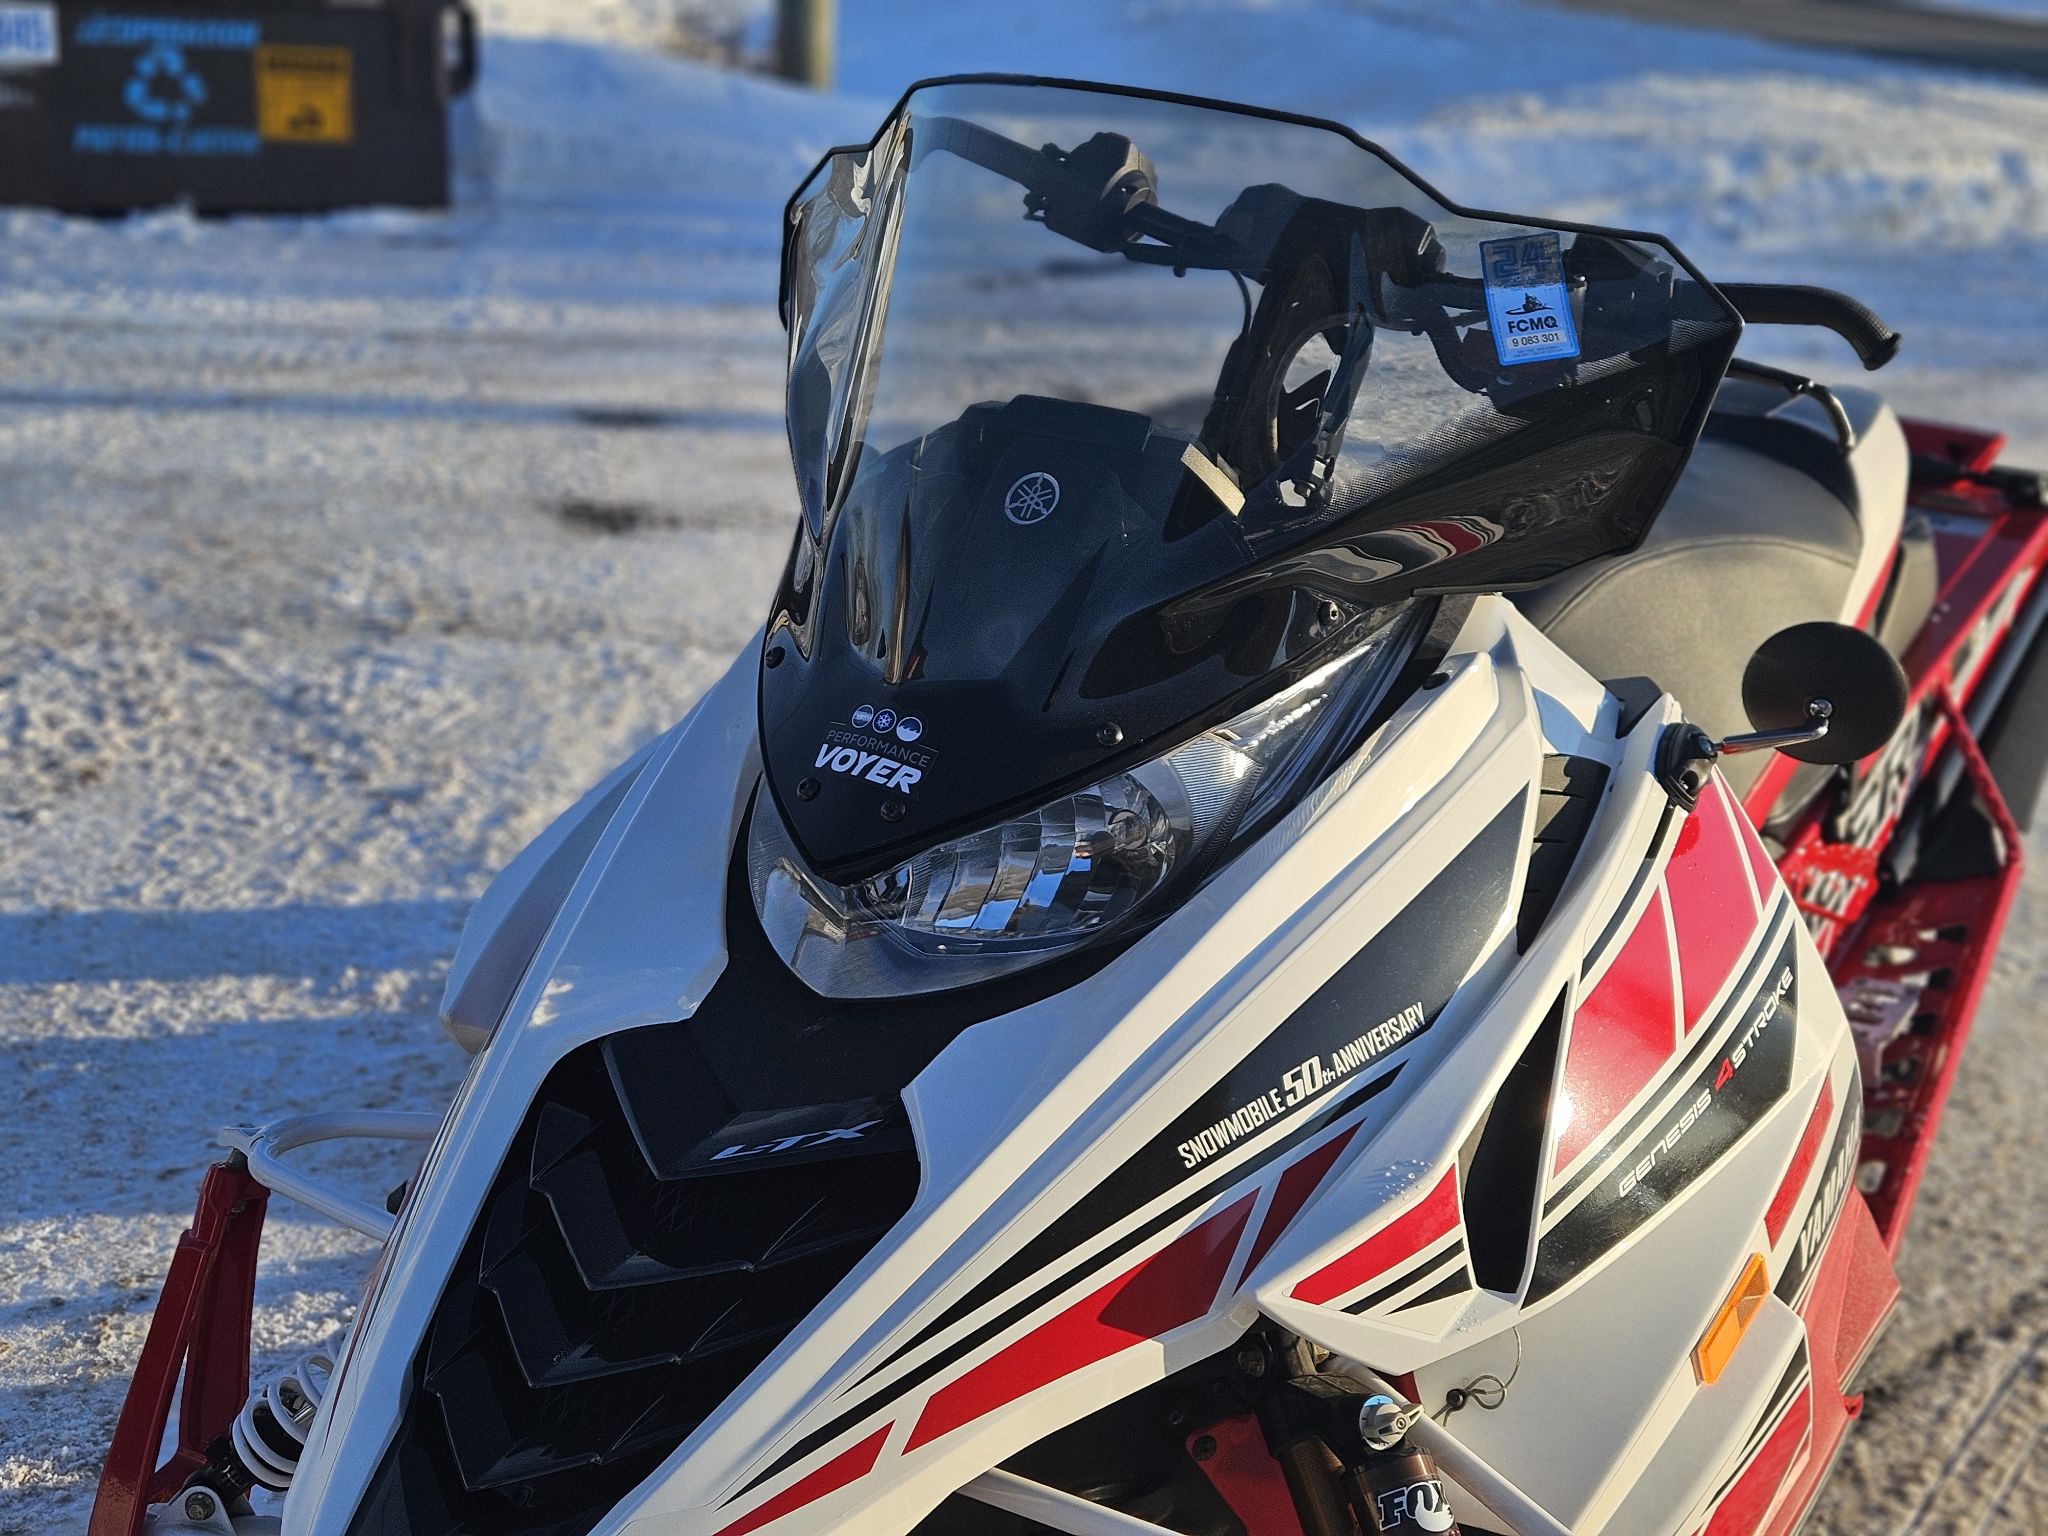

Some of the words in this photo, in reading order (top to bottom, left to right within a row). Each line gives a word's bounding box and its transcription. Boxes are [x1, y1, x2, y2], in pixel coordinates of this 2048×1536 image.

[1492, 241, 1556, 279] 24
[1508, 316, 1558, 333] FCMQ
[1512, 338, 1519, 347] 9
[1521, 335, 1540, 346] 083
[1542, 333, 1559, 343] 301
[814, 743, 922, 794] VOYER
[826, 730, 930, 768] PERFORMANCE
[1178, 1088, 1287, 1169] SNOWMOBILE
[1333, 1002, 1426, 1077] ANNIVERSARY
[1618, 1088, 1712, 1198] GENESIS
[1800, 1102, 1861, 1273] YAMAHA
[1377, 1480, 1455, 1532] FOX
